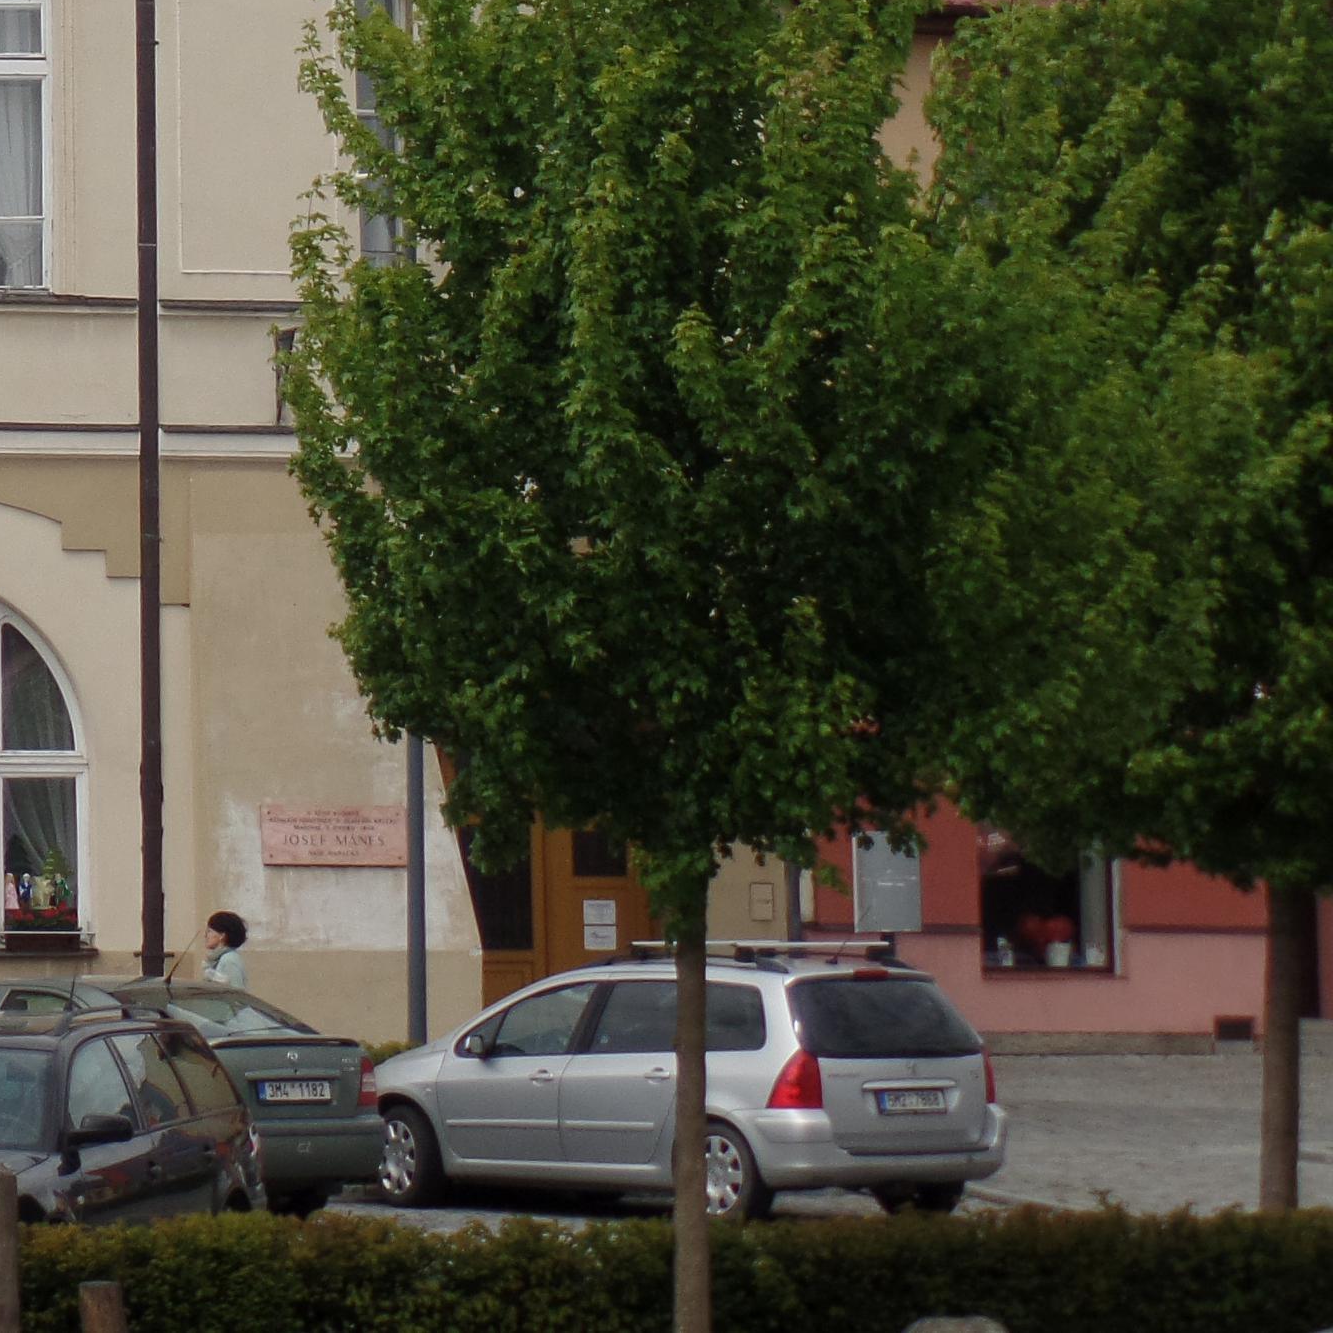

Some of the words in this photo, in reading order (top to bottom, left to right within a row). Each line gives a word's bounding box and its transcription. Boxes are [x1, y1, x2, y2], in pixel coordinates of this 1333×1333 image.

[282, 833, 326, 847] JOSEF
[335, 832, 386, 847] MÁNES
[268, 1081, 290, 1098] 3M4
[298, 1081, 326, 1098] 1182
